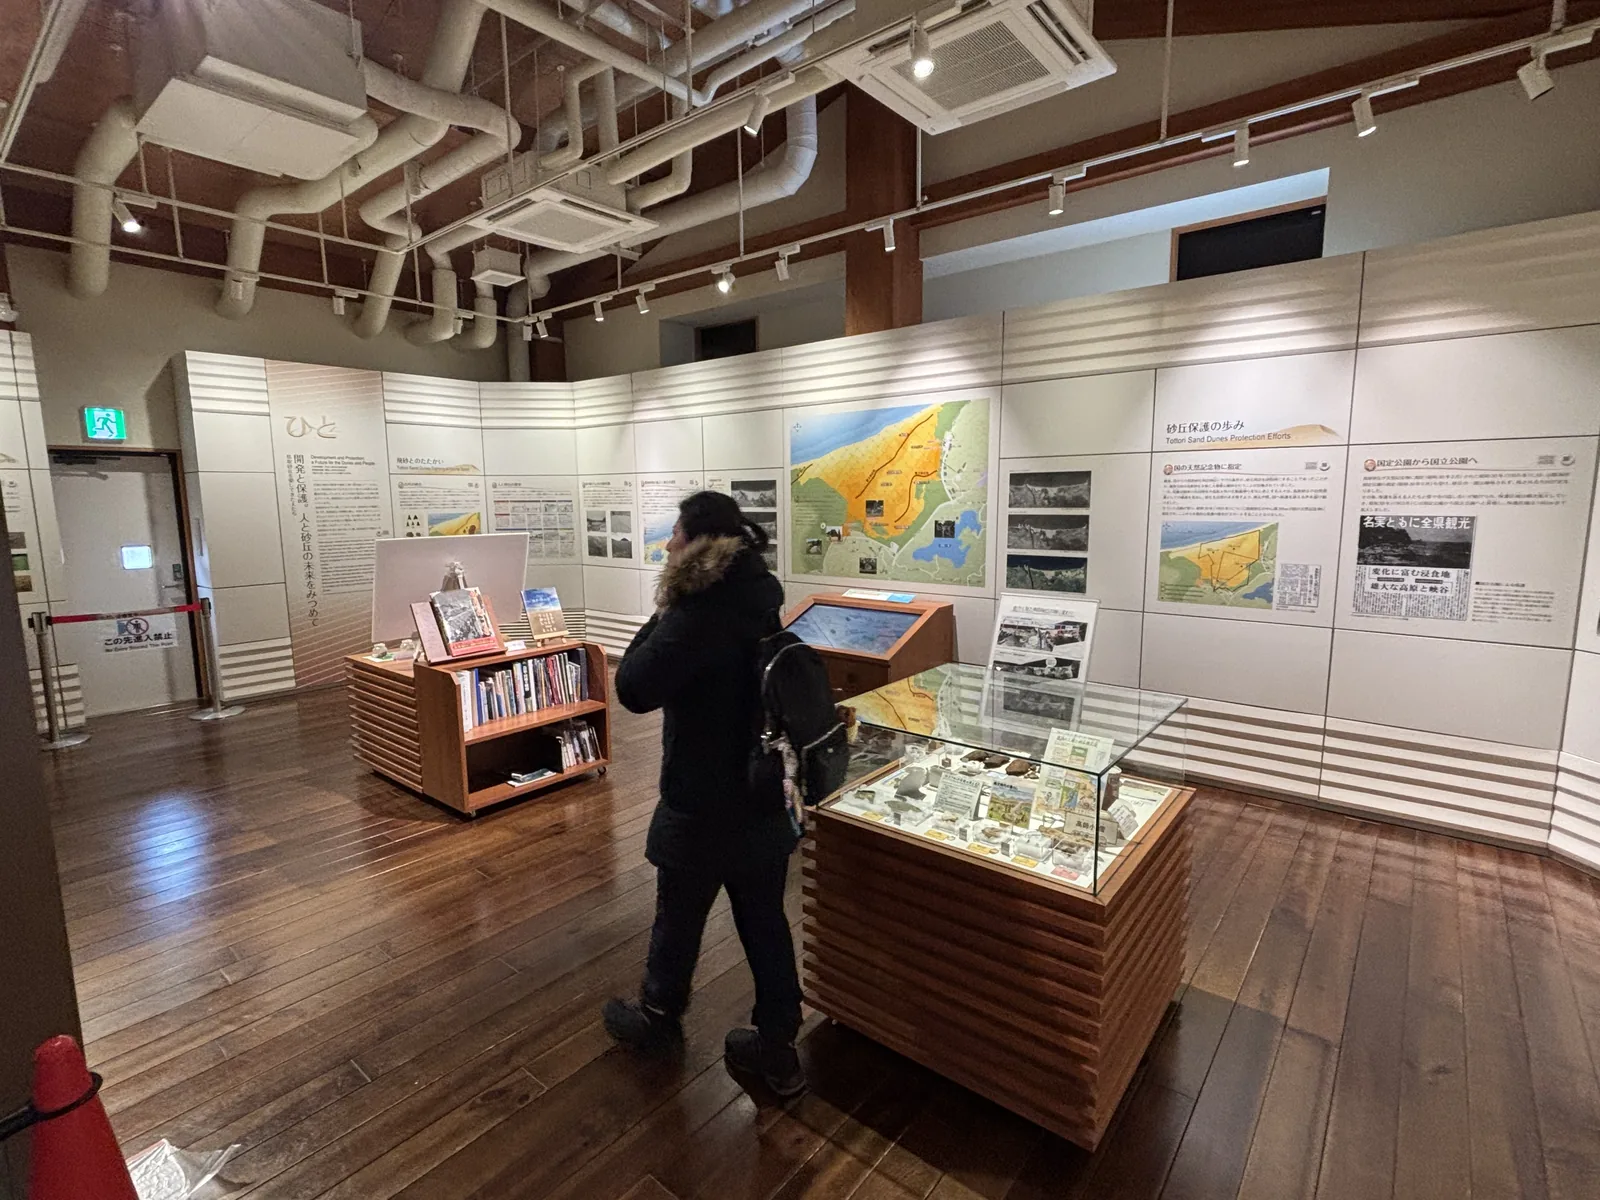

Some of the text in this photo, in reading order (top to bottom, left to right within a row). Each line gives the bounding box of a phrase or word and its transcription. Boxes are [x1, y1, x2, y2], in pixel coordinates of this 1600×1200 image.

[284, 415, 338, 439] ひと
[1166, 420, 1245, 434] 砂丘保護の歩み
[1166, 437, 1186, 445] Tottori
[1206, 435, 1228, 443] Dunes
[1230, 433, 1266, 441] Protection
[1267, 432, 1291, 440] Efforts
[1173, 463, 1242, 471] 国の天然記念物に指定
[1376, 457, 1478, 467] 国定公園から国立公園へ
[1363, 516, 1471, 530] 名実ともに全県観光
[1371, 567, 1451, 578] 変化に富む浸食地
[104, 632, 173, 646] この先進入禁止
